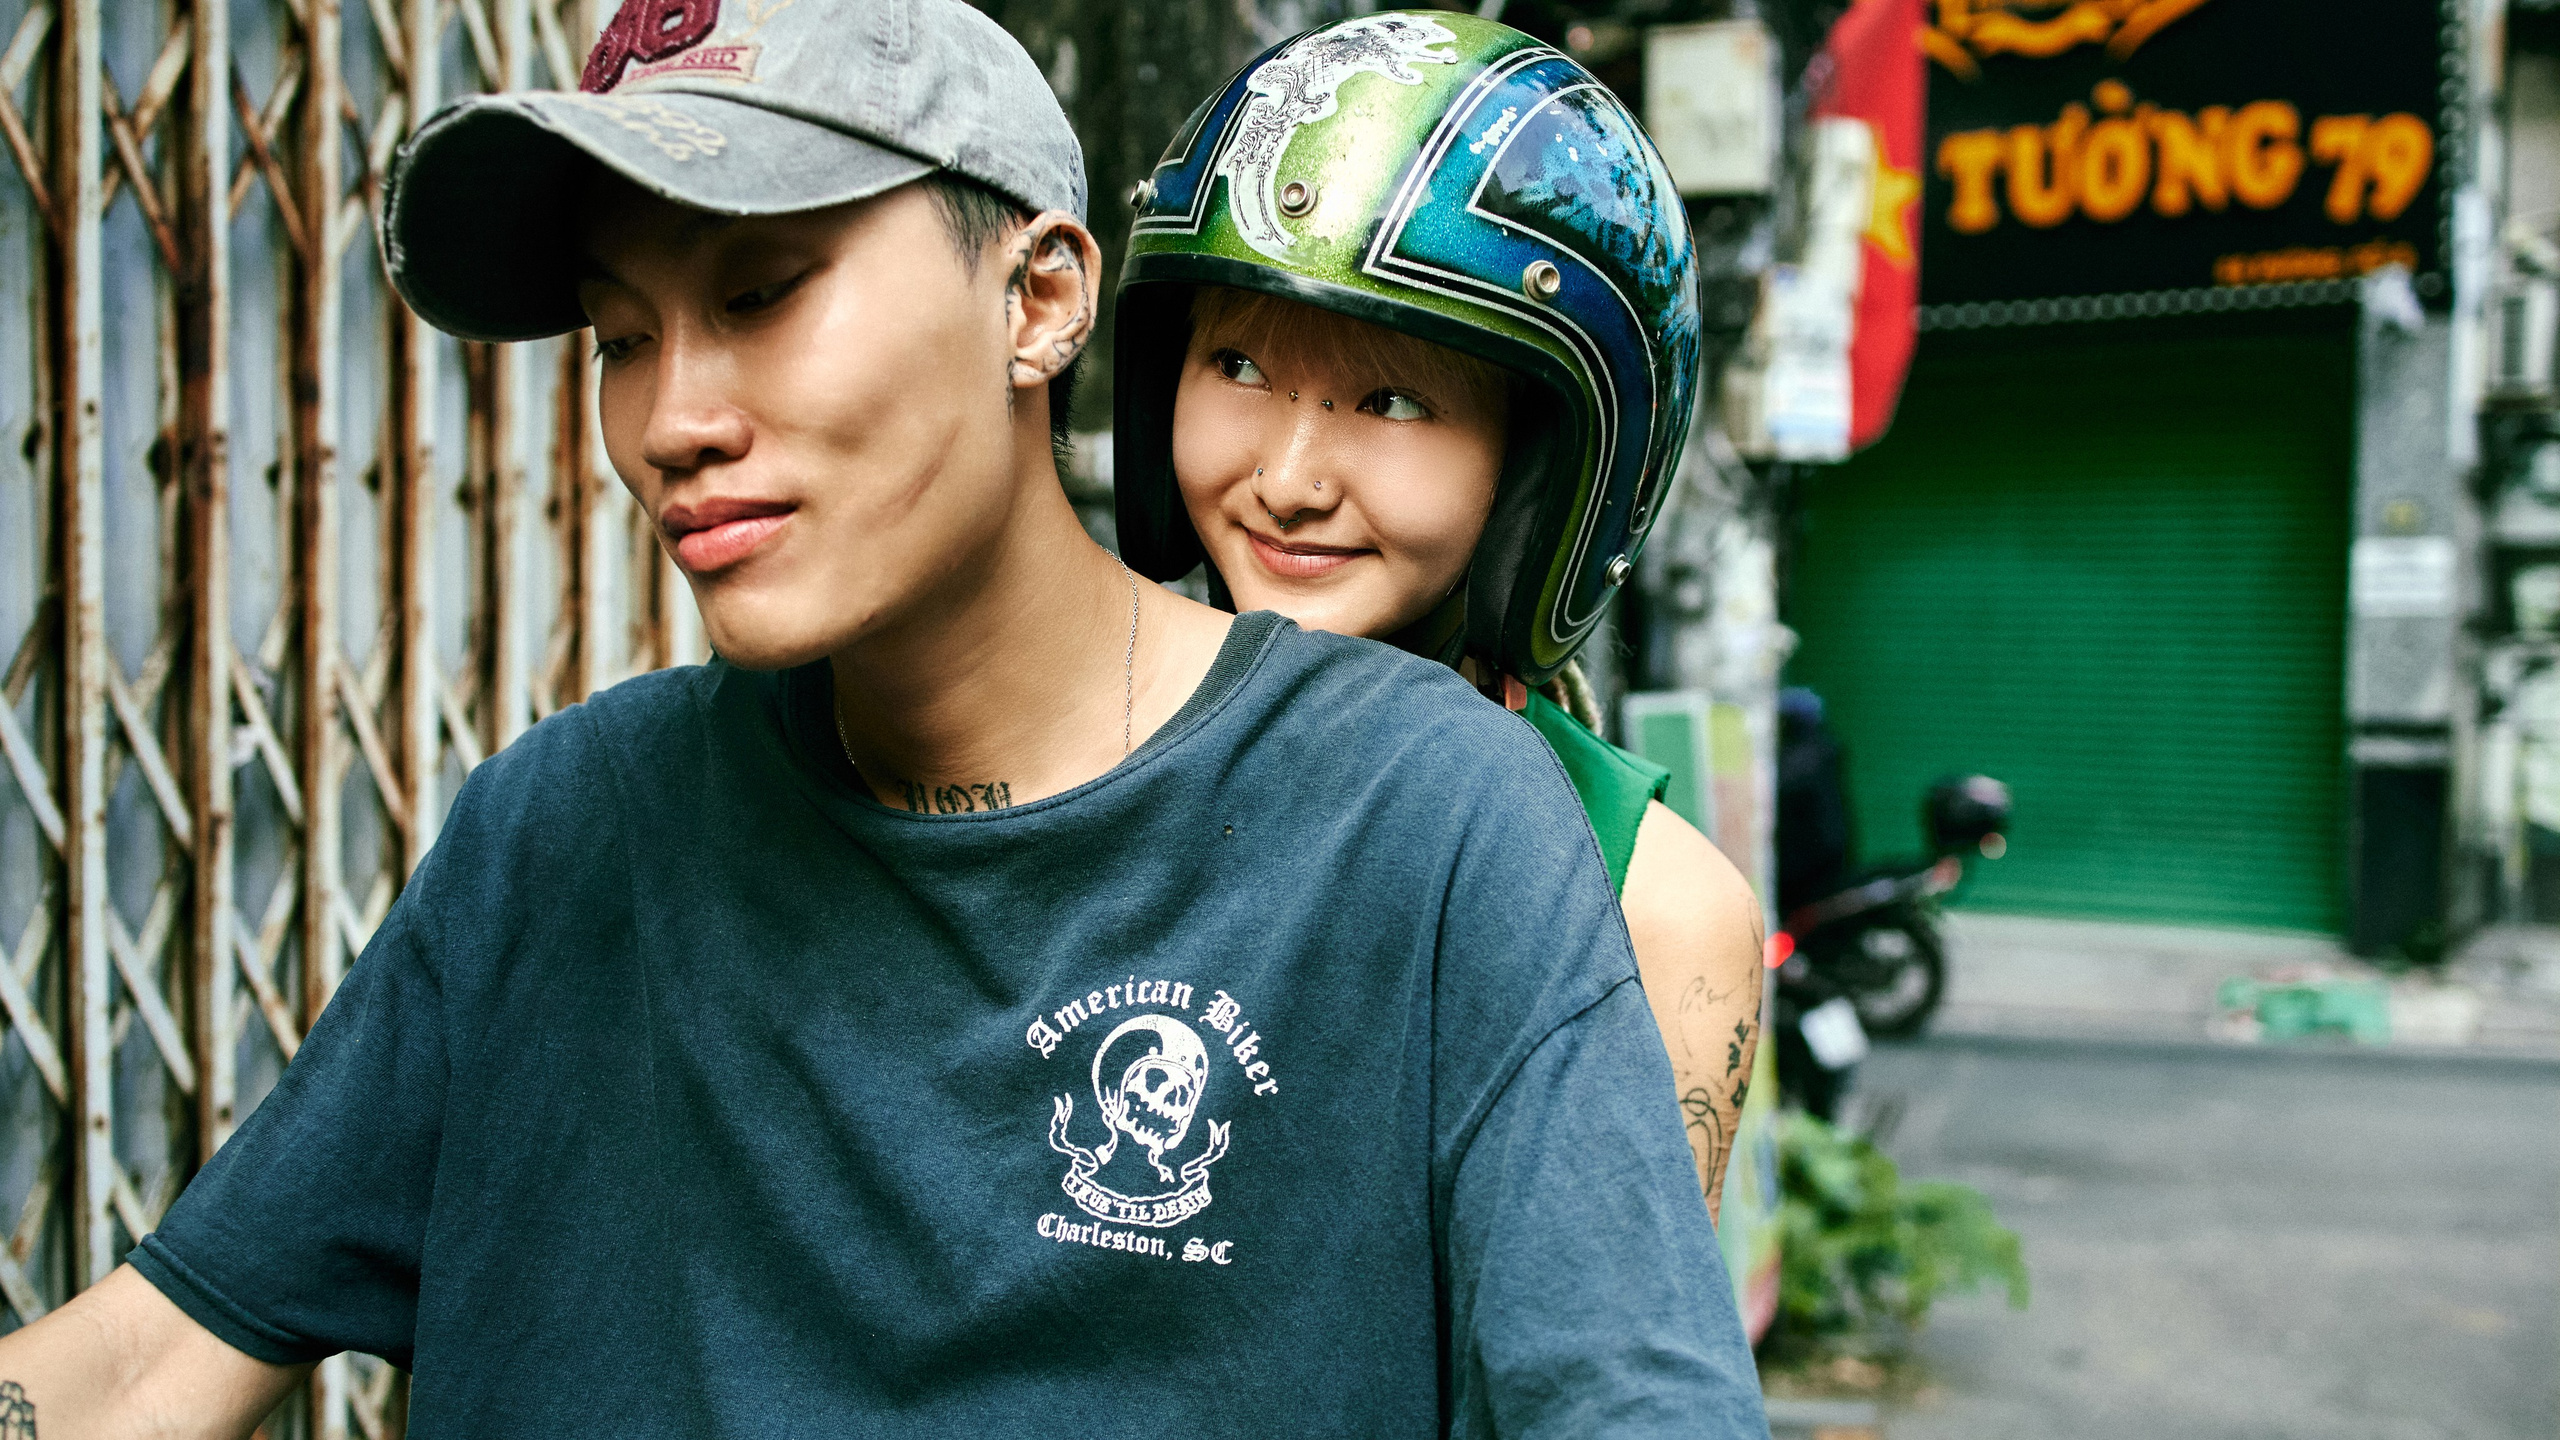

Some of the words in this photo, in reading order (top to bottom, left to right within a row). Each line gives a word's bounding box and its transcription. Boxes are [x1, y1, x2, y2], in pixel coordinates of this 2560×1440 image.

[2309, 112, 2434, 225] 79
[1026, 975, 1194, 1059] American
[1199, 990, 1278, 1097] Biker
[1037, 1213, 1173, 1260] Charleston,
[1182, 1237, 1234, 1265] SC
[1152, 1186, 1209, 1221] DEATH
